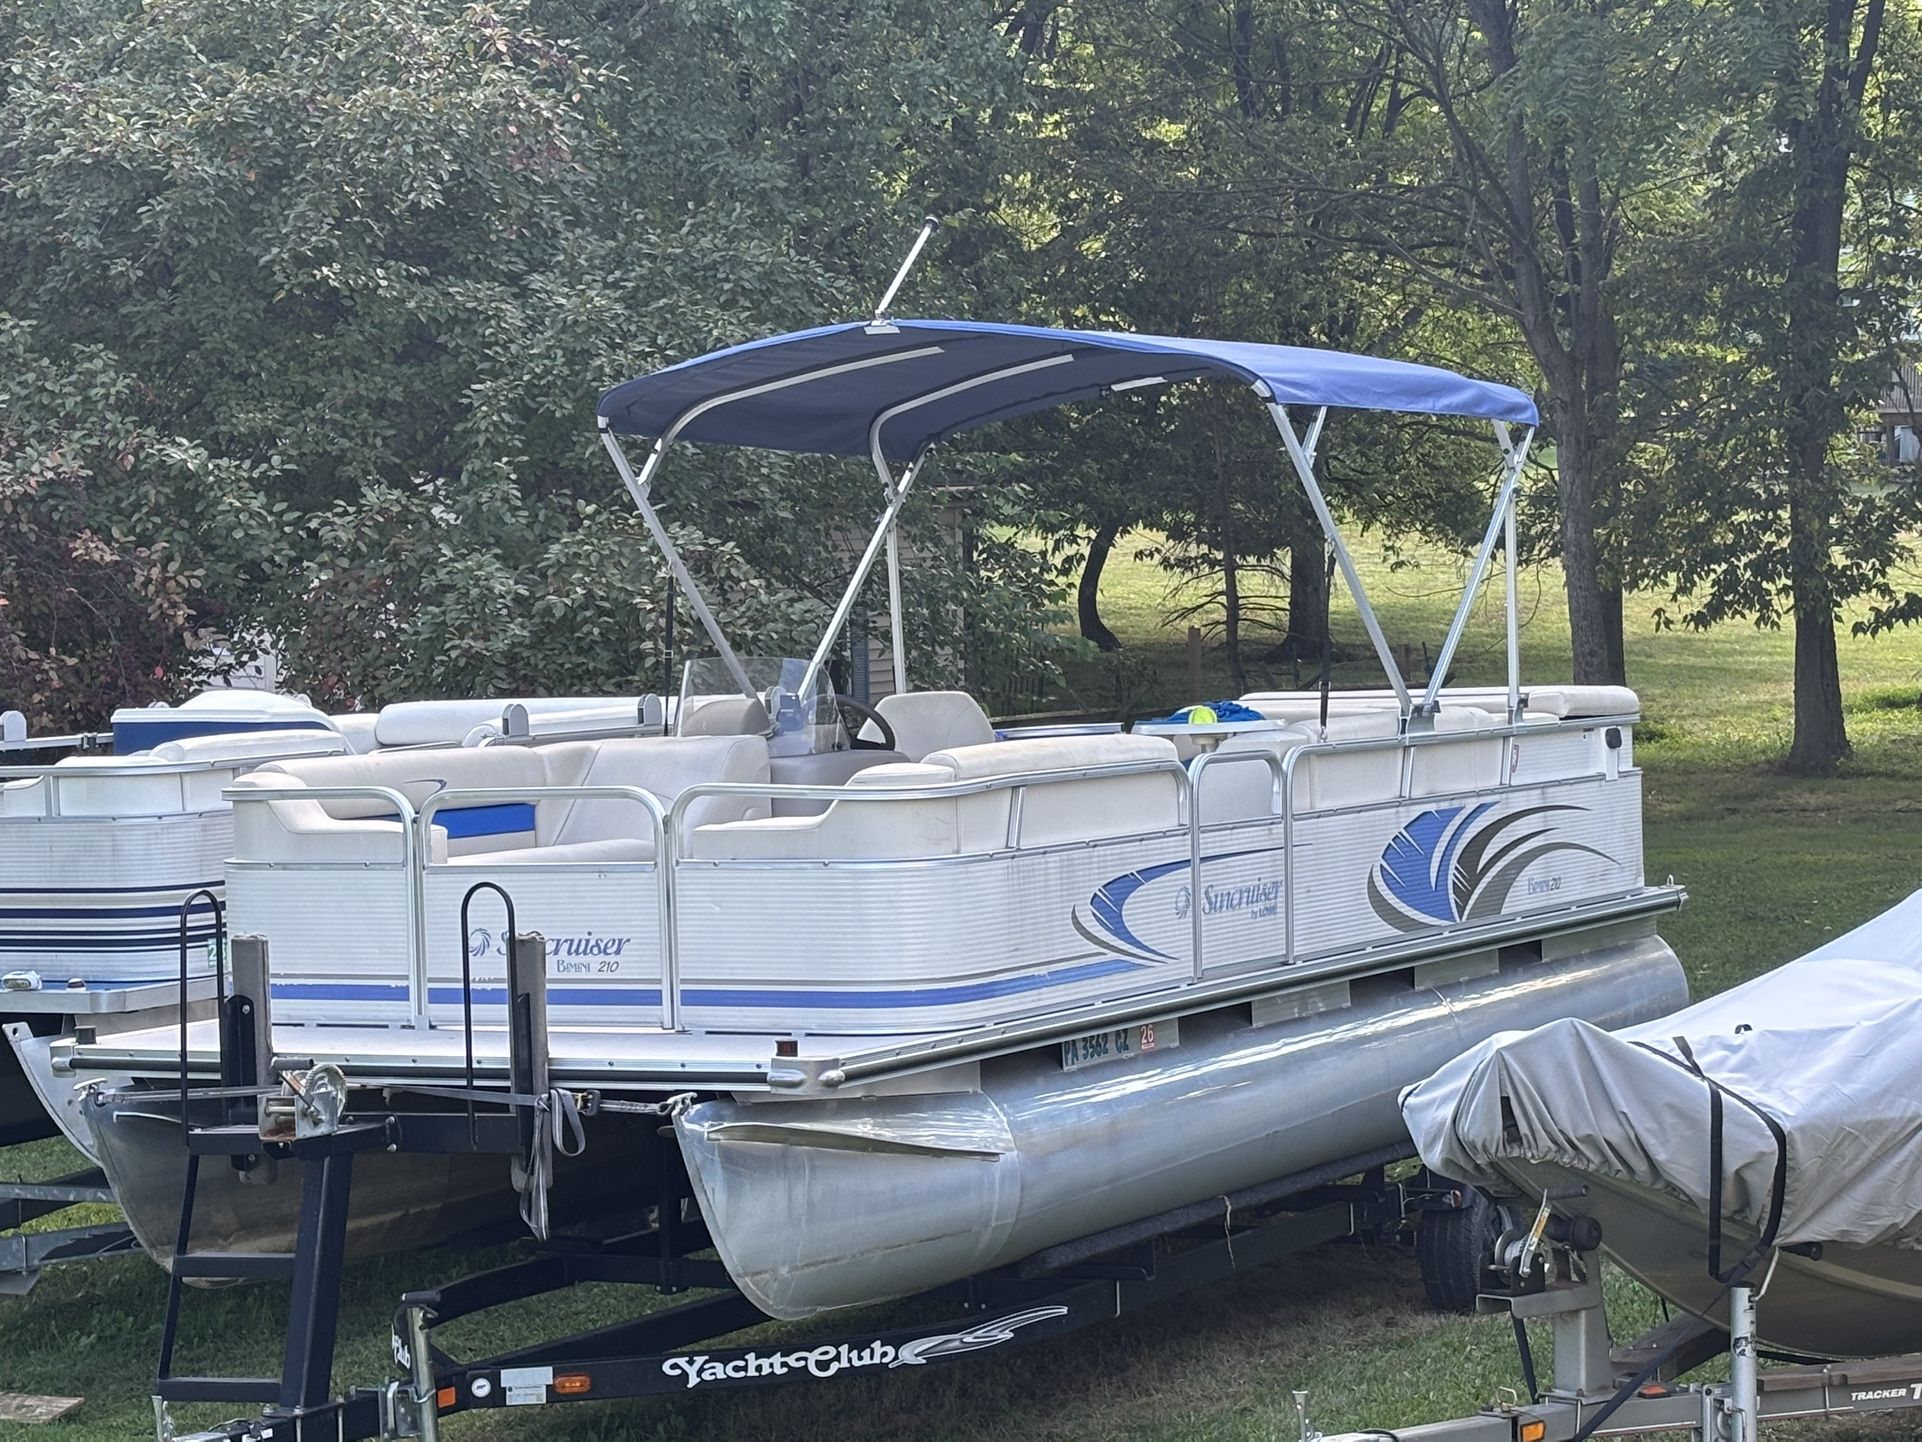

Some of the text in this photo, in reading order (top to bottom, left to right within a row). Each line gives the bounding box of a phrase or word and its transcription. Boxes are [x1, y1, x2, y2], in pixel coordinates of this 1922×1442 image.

[1202, 877, 1284, 915] Suncruiser
[597, 960, 620, 973] 210
[1140, 1024, 1154, 1043] 26
[1063, 1039, 1080, 1066] PA
[1850, 1388, 1907, 1401] TRACKER
